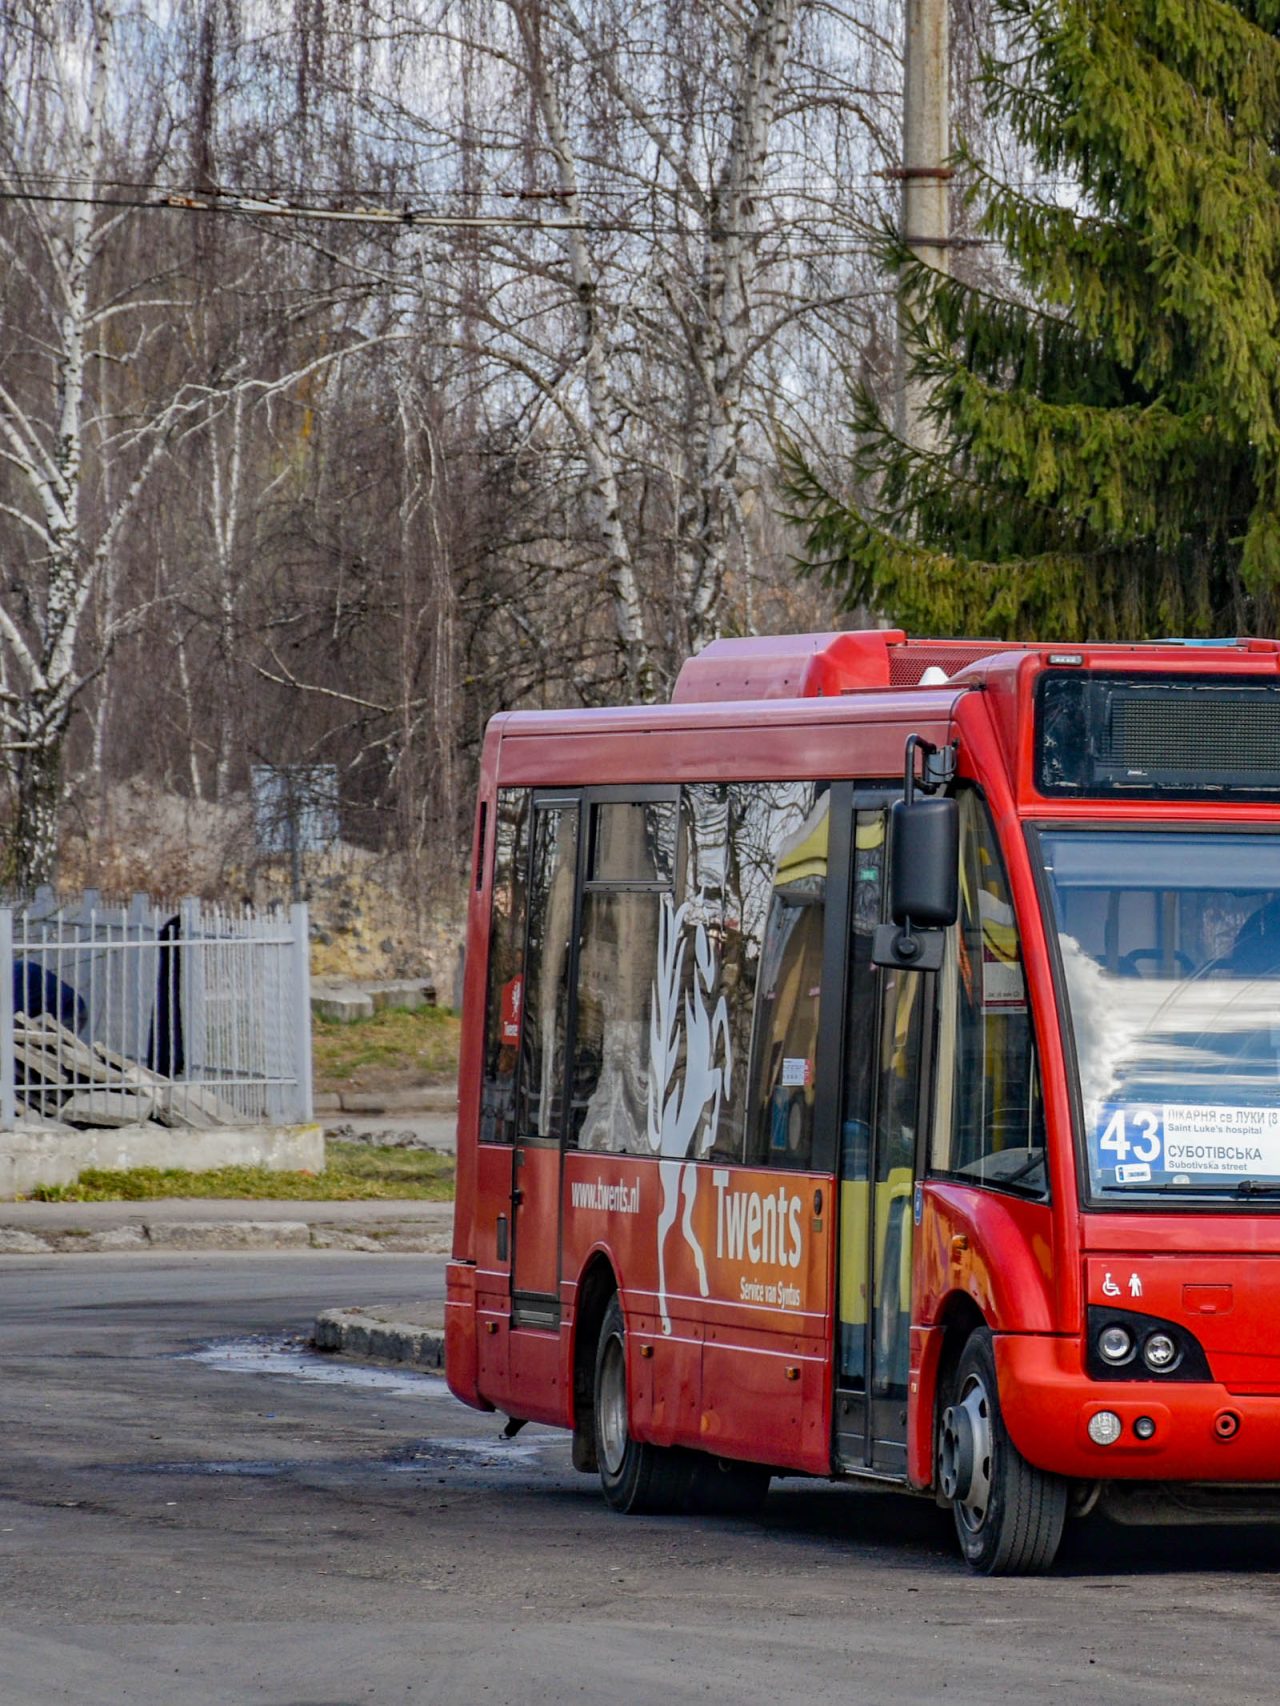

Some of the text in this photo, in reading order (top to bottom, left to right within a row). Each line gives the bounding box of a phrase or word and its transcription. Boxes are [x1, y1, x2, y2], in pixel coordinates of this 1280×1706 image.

[1168, 1123, 1262, 1135] Saint Luke's hospital
[1235, 1111, 1265, 1124] ЛУКИ
[1268, 1112, 1278, 1127] (8
[1100, 1110, 1161, 1162] 43
[1168, 1145, 1263, 1161] СУБОТІВСЬКА
[1168, 1160, 1248, 1171] Subotivska street
[571, 1176, 640, 1214] www.twents.nl
[712, 1169, 801, 1268] Twents
[740, 1276, 800, 1310] Service van Syntus
